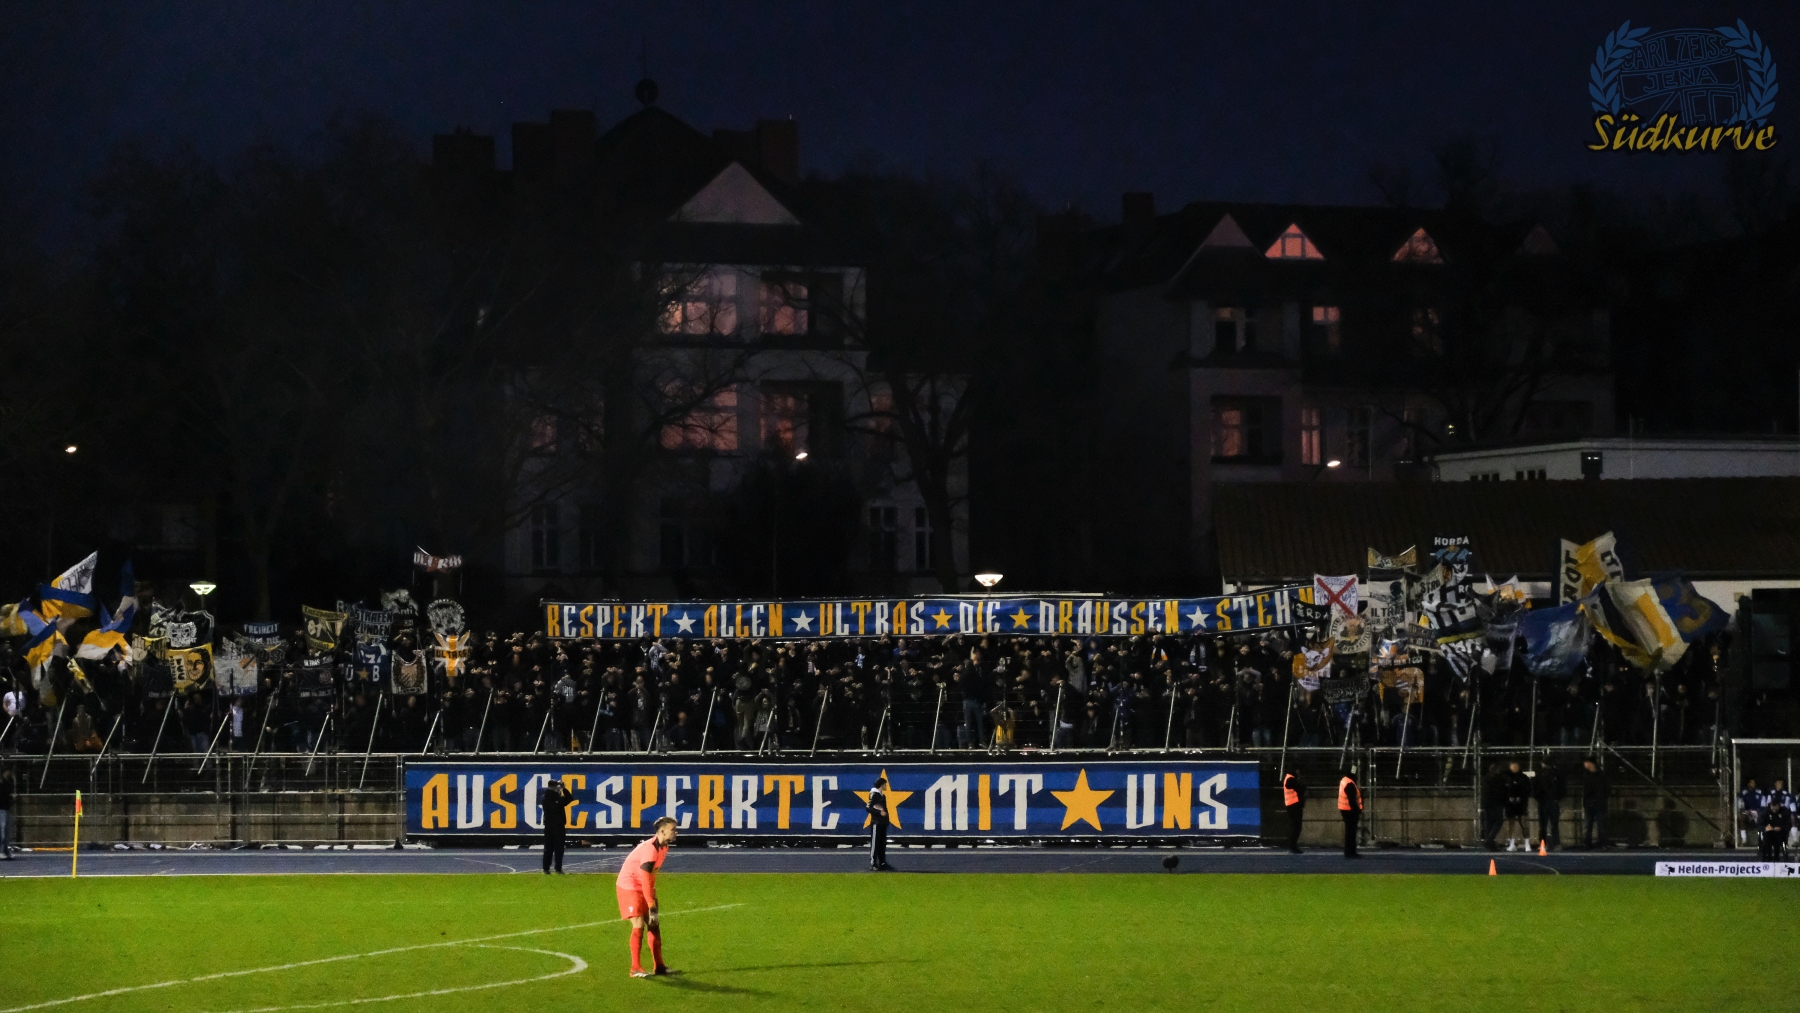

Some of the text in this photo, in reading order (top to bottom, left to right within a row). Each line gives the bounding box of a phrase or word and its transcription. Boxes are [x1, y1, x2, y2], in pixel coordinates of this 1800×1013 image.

[1434, 536, 1470, 546] HORDA
[243, 624, 279, 634] FREIHEIT
[547, 604, 668, 637] RESPEKT
[704, 603, 782, 637] ALLEN
[819, 601, 925, 636] ULTRAS
[959, 600, 1000, 633] DIE
[1039, 600, 1179, 635] DRAUSSEN
[421, 772, 1228, 830] AUSGESPERRTE MIT UNS
